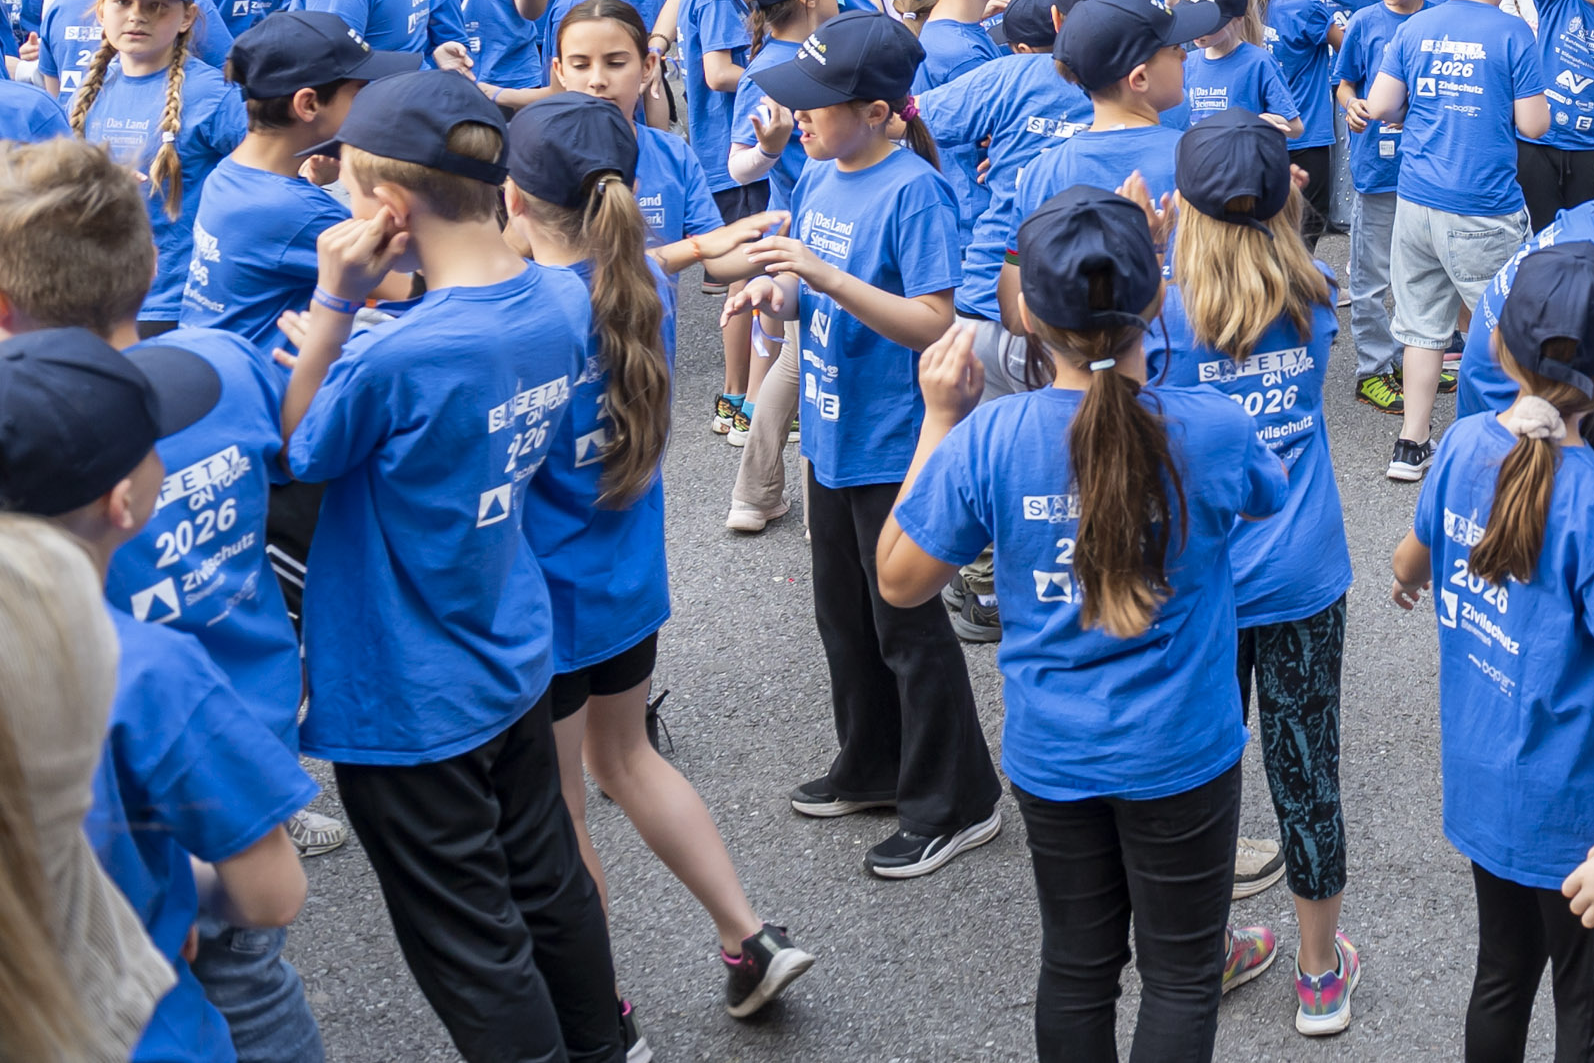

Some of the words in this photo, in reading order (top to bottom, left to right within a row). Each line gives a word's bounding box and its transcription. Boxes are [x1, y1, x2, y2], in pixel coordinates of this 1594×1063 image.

[1430, 60, 1474, 77] 2026
[1195, 86, 1209, 97] Das
[1209, 86, 1227, 97] Land
[106, 117, 123, 130] Das
[125, 117, 150, 131] Land
[639, 192, 662, 207] and
[815, 212, 831, 229] Das
[830, 216, 854, 236] Land
[1202, 349, 1307, 380] SAFETY
[1261, 371, 1282, 387] ON
[1281, 356, 1315, 383] TOUR
[1255, 414, 1315, 441] vilschutz
[158, 449, 238, 502] FETY
[188, 488, 216, 512] ON
[155, 498, 237, 569] 2026
[1461, 601, 1520, 655] Zivilschutz
